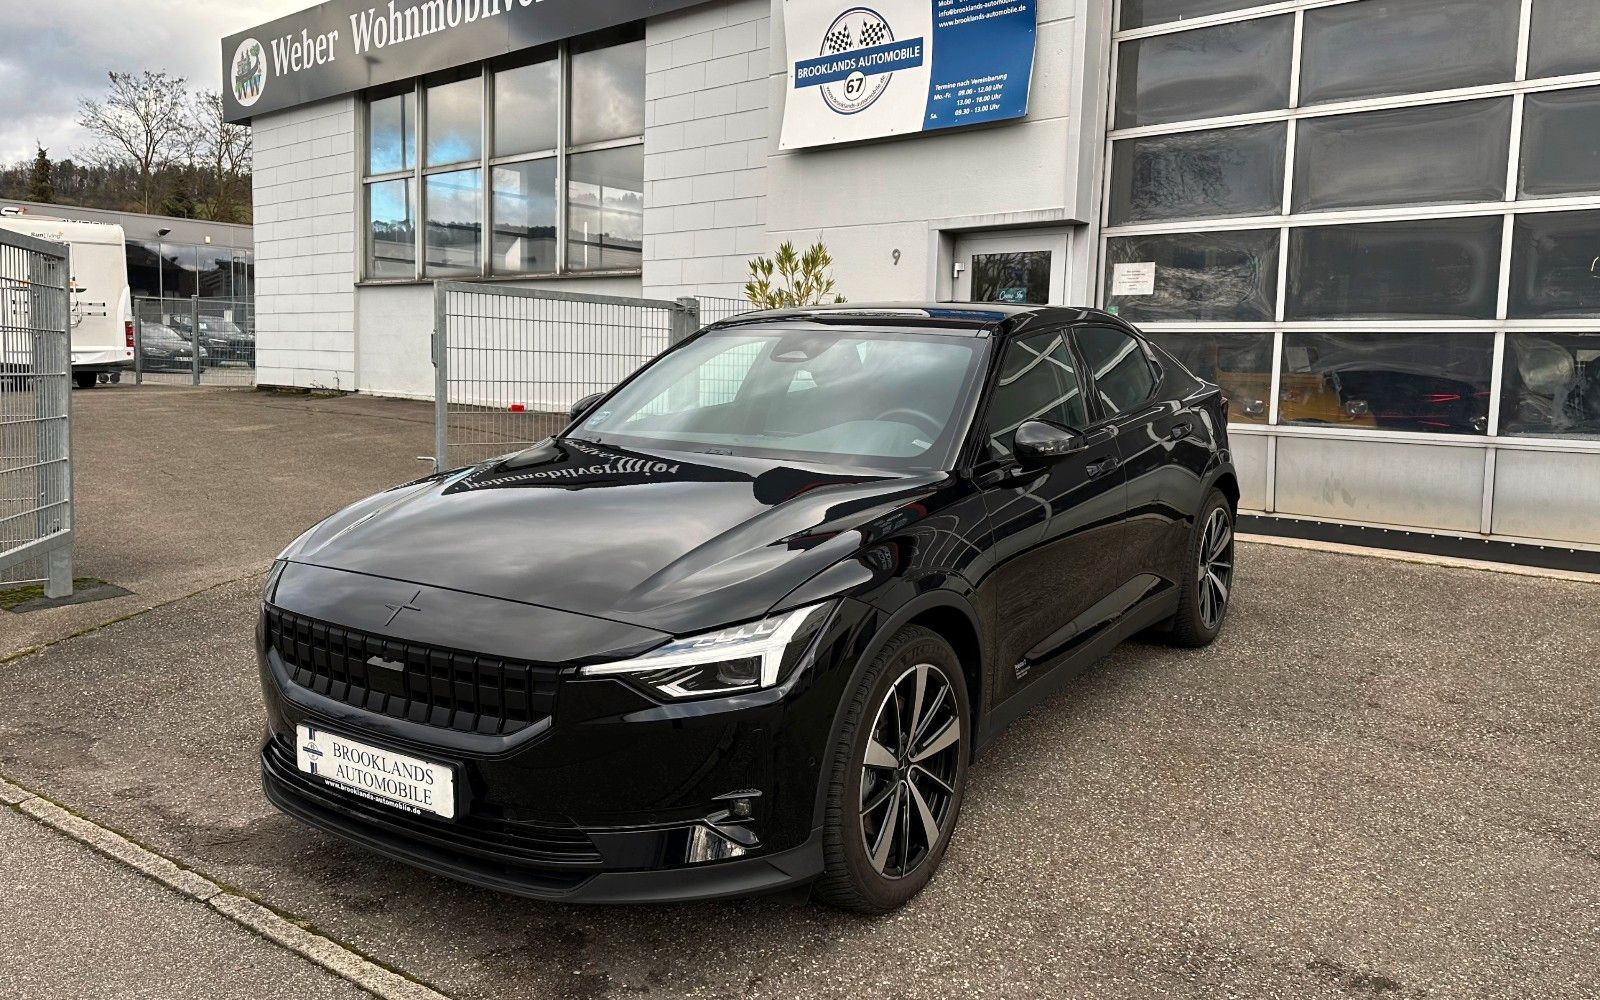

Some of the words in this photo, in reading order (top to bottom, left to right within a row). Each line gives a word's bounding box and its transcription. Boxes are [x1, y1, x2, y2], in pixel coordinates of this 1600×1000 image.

[938, 4, 1026, 28] www.brooklands-automobile.de
[271, 29, 339, 77] Weber
[797, 58, 856, 79] BROOKLANDS
[858, 45, 920, 67] AUTOMOBILE
[846, 77, 864, 94] 67
[935, 83, 956, 91] Termine
[956, 80, 970, 88] nach
[971, 73, 1008, 85] Vereinbarung
[992, 83, 1004, 91] Uhr
[989, 103, 1001, 111] Uhr
[991, 93, 1002, 101] Uhr
[891, 248, 901, 266] 9
[332, 741, 434, 786] BROOKLANDS
[335, 763, 433, 806] AUTOMOBILE
[324, 779, 422, 815] www.brooklands-automobile.de
